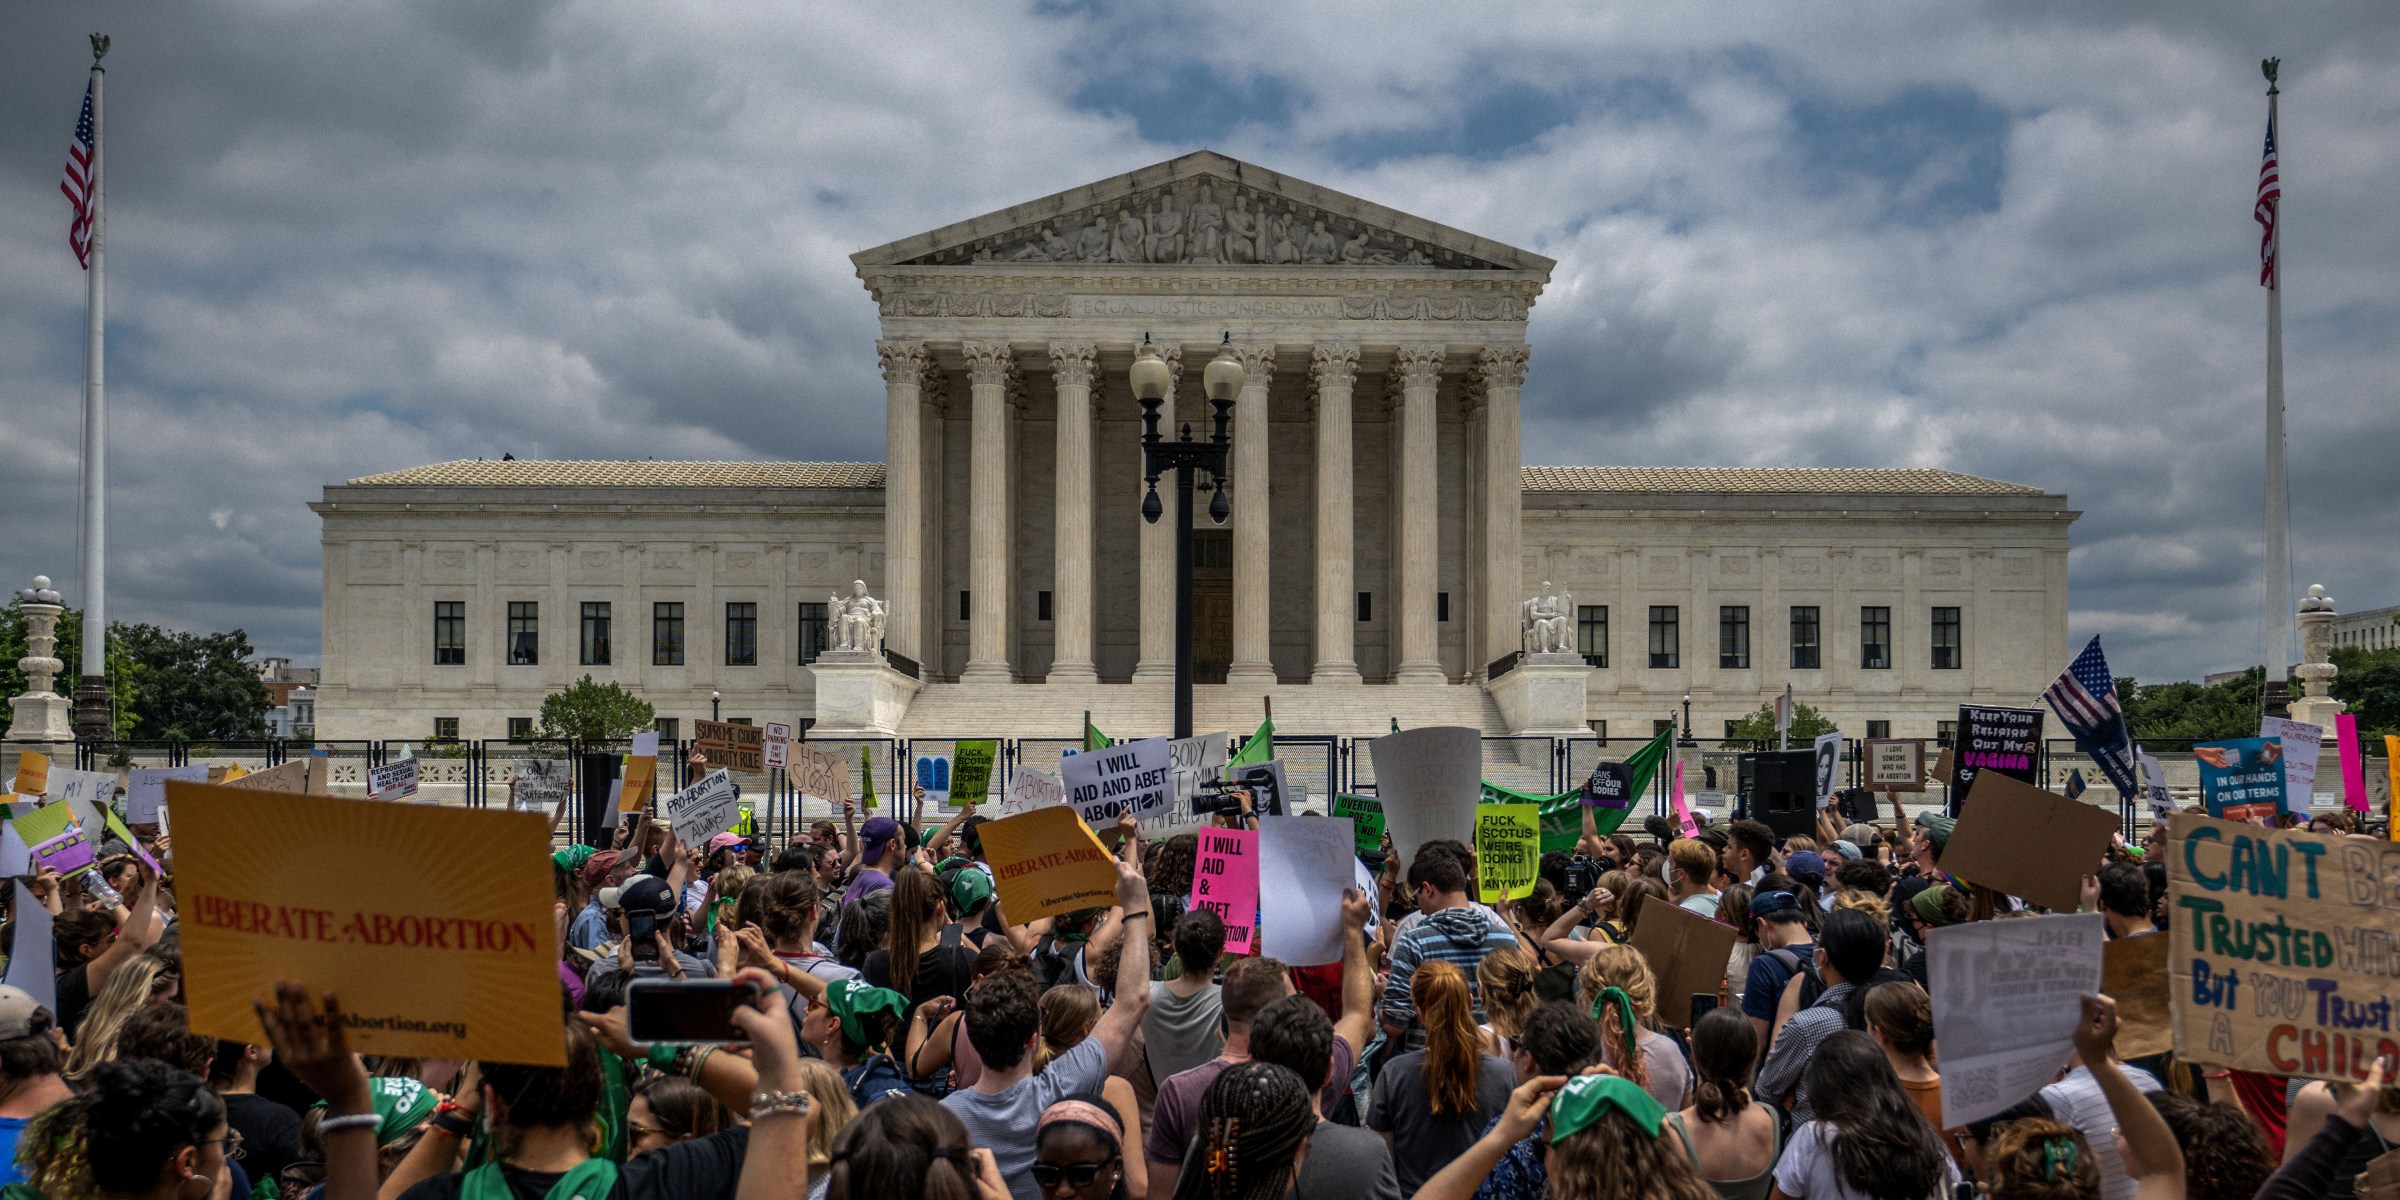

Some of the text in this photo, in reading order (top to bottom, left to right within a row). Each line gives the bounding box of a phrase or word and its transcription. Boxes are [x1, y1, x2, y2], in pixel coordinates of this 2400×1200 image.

[1084, 301, 1326, 315] EQUAL JUSTICE UNDER LAW
[697, 723, 761, 744] SUPREME COURT
[773, 726, 782, 735] NO
[2280, 731, 2320, 744] MURDER
[768, 735, 787, 744] PARKING
[740, 752, 760, 769] RULE
[801, 747, 835, 777] HEX
[958, 756, 991, 764] SCOTUS
[1169, 740, 1206, 770] BODY
[1963, 751, 2029, 770] VAGINA
[371, 758, 417, 776] REPRODUCTIVE
[527, 766, 549, 777] ONLY
[1096, 752, 1141, 776] I WILL
[377, 766, 413, 781] AND SEXUAL
[377, 771, 414, 788] HEALTH CARE
[1593, 771, 1611, 780] BANS
[2216, 772, 2277, 787] IN OUR HANDS
[64, 778, 85, 799] MY
[385, 783, 397, 792] FOR
[398, 780, 408, 788] ALL
[546, 782, 569, 791] WHITE
[1073, 783, 1098, 804] AID
[1102, 776, 1132, 799] AND
[1134, 767, 1168, 791] ABET
[1592, 778, 1622, 789] OFF OUR
[1592, 786, 1619, 796] BODIES
[666, 771, 727, 814] PRO-ABORTION
[2217, 787, 2280, 802] ON OUR TERMS
[1004, 801, 1023, 815] IS
[691, 808, 726, 842] ALWAYS!
[1483, 815, 1516, 826] FUCK
[1361, 826, 1377, 838] NO!
[1483, 829, 1533, 839] SCOTUS
[1205, 836, 1242, 856] I WILL
[1483, 841, 1522, 851] WE'RE
[1000, 847, 1106, 880] LIBERATE ABORT
[1483, 853, 1522, 863] DOING
[2184, 826, 2327, 899] CAN'T
[1201, 857, 1225, 875] AID
[1485, 867, 1494, 876] IT
[1199, 878, 1210, 896] &
[1485, 877, 1532, 889] ANYWAY
[193, 894, 537, 954] LIBERATE ABORTION
[2250, 973, 2306, 1021] YOU
[2209, 1012, 2400, 1083] A CHILD
